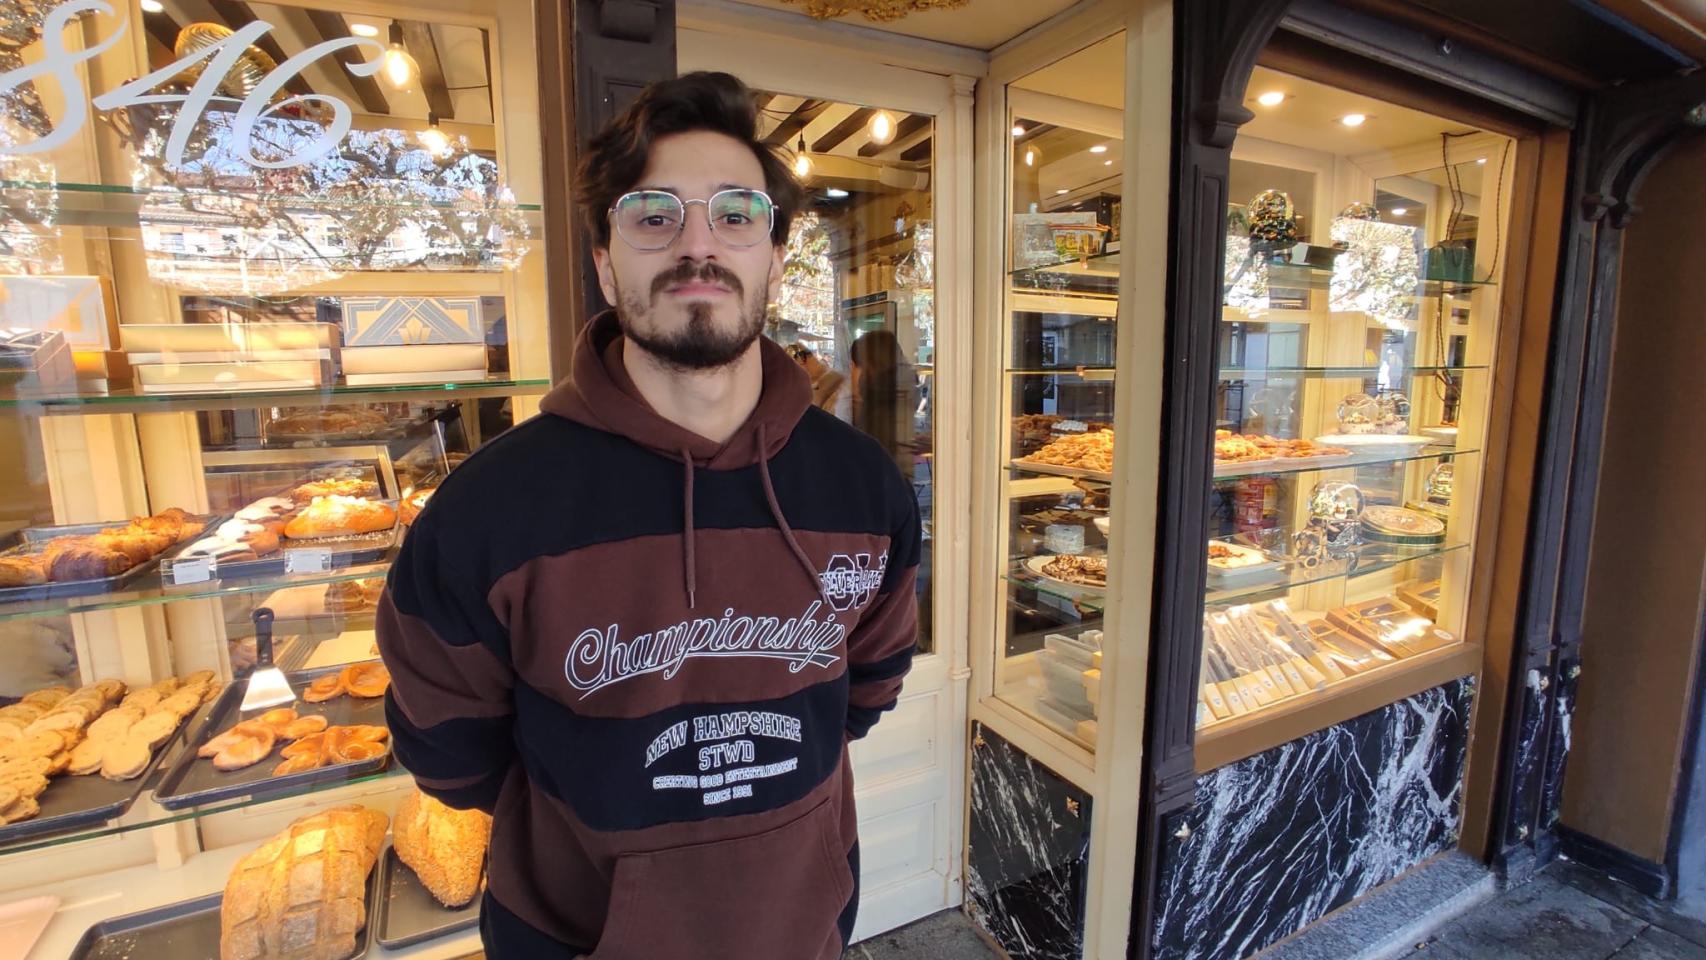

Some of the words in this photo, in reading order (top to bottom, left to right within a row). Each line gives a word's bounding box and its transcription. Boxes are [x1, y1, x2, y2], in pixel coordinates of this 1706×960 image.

[565, 600, 846, 692] Championship
[645, 720, 688, 768] NEW
[693, 711, 802, 743] HAMPSHIRE
[698, 740, 755, 771] STWD
[699, 773, 724, 789] GOOD
[724, 757, 798, 784] ENTERTAINMENT
[703, 787, 732, 805] SINCE
